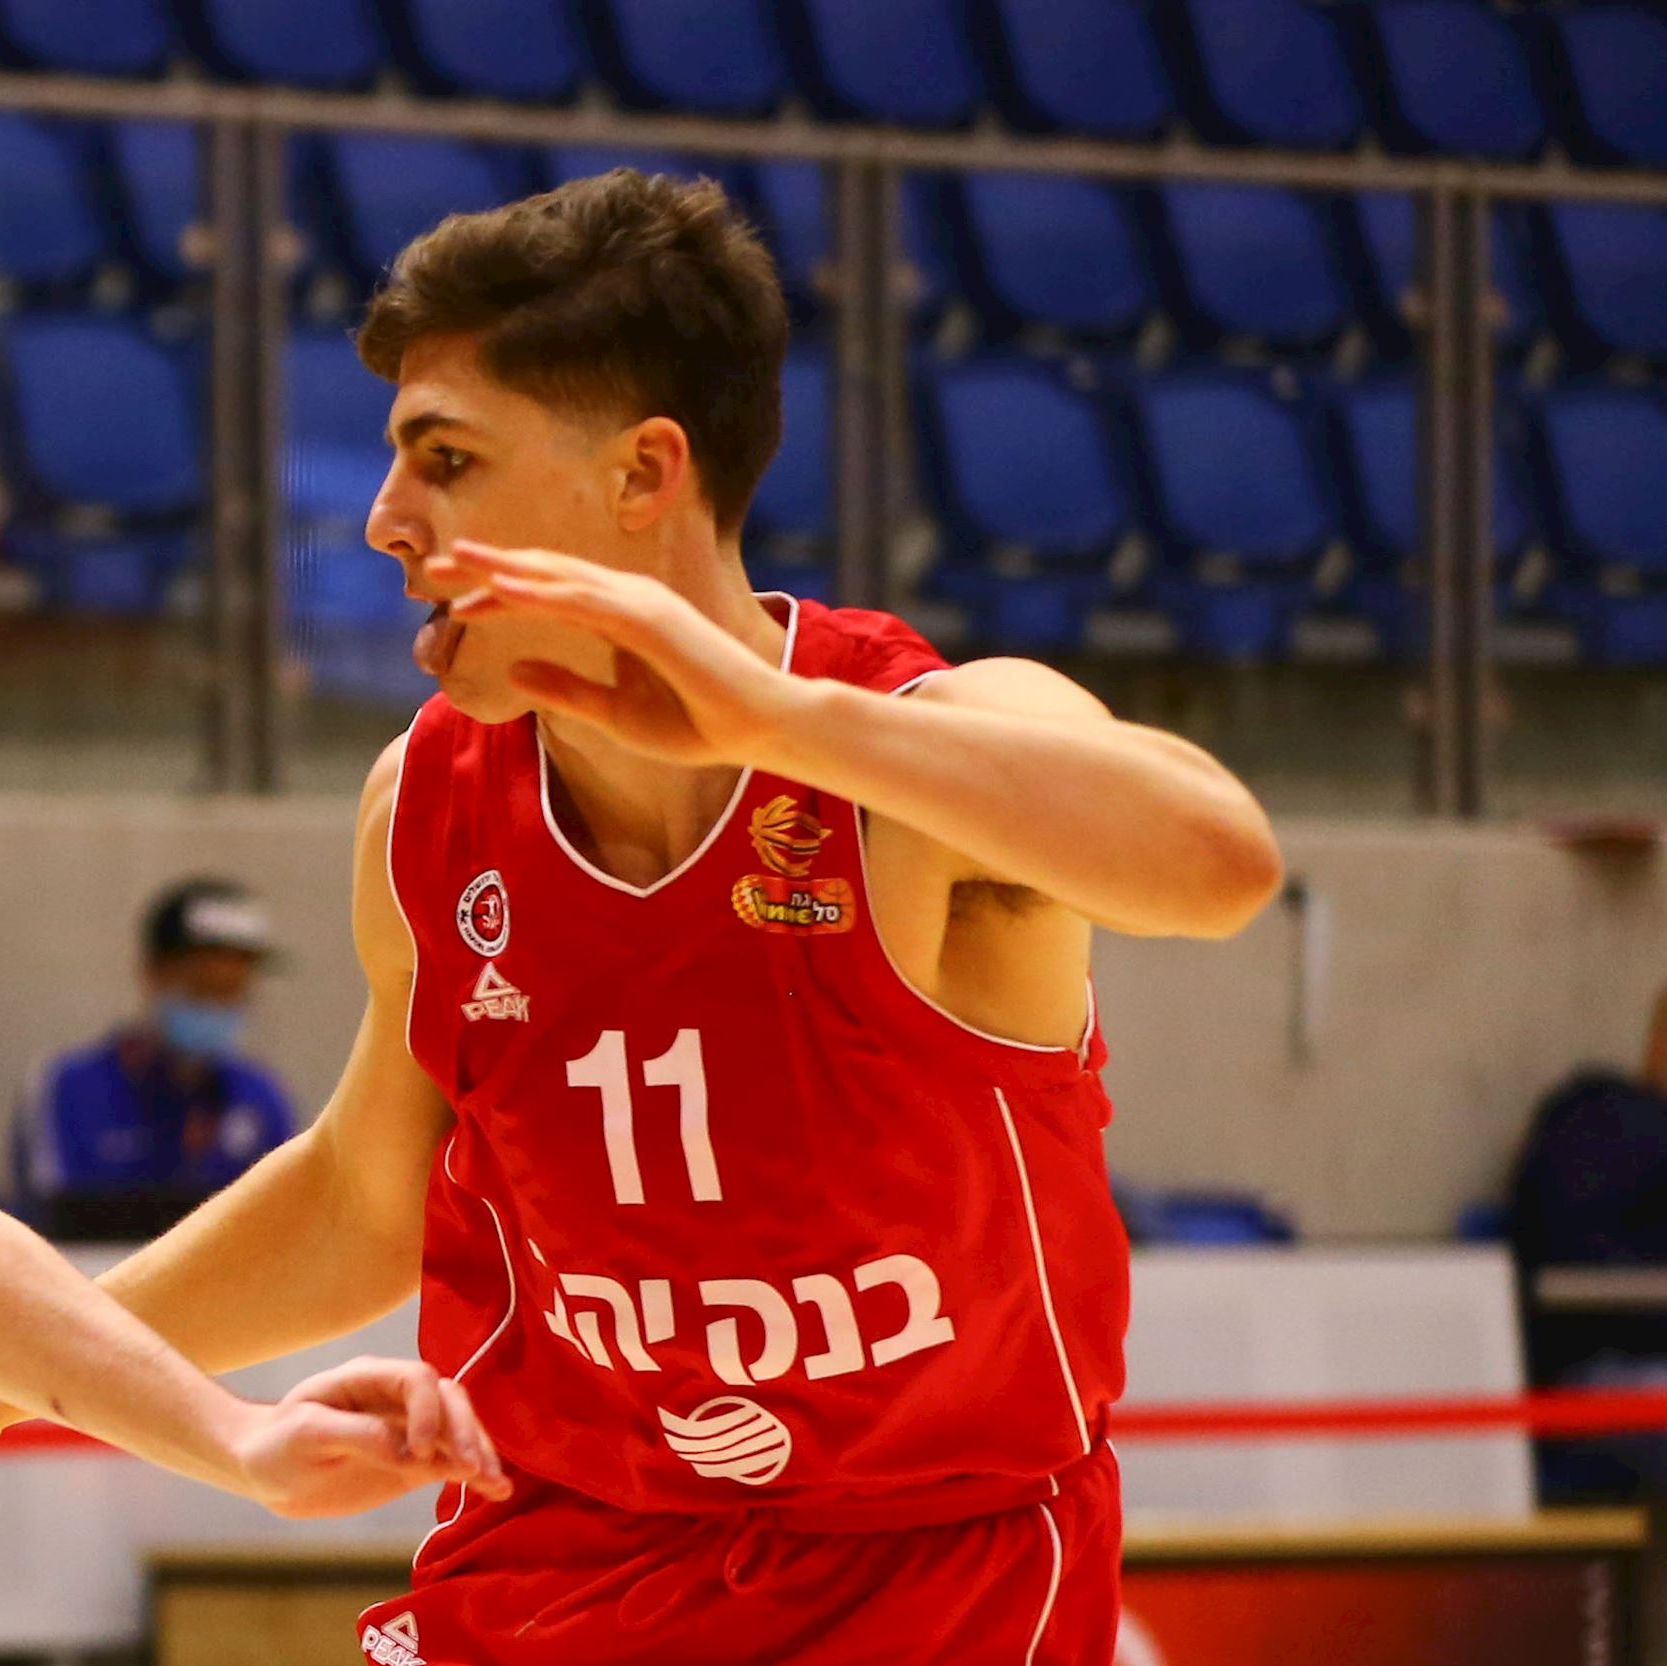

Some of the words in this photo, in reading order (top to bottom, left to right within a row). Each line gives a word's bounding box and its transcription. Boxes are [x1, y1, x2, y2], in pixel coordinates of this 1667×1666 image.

[461, 995, 531, 1023] PEAK
[567, 1028, 723, 1205] 11
[698, 1253, 956, 1387] בנק
